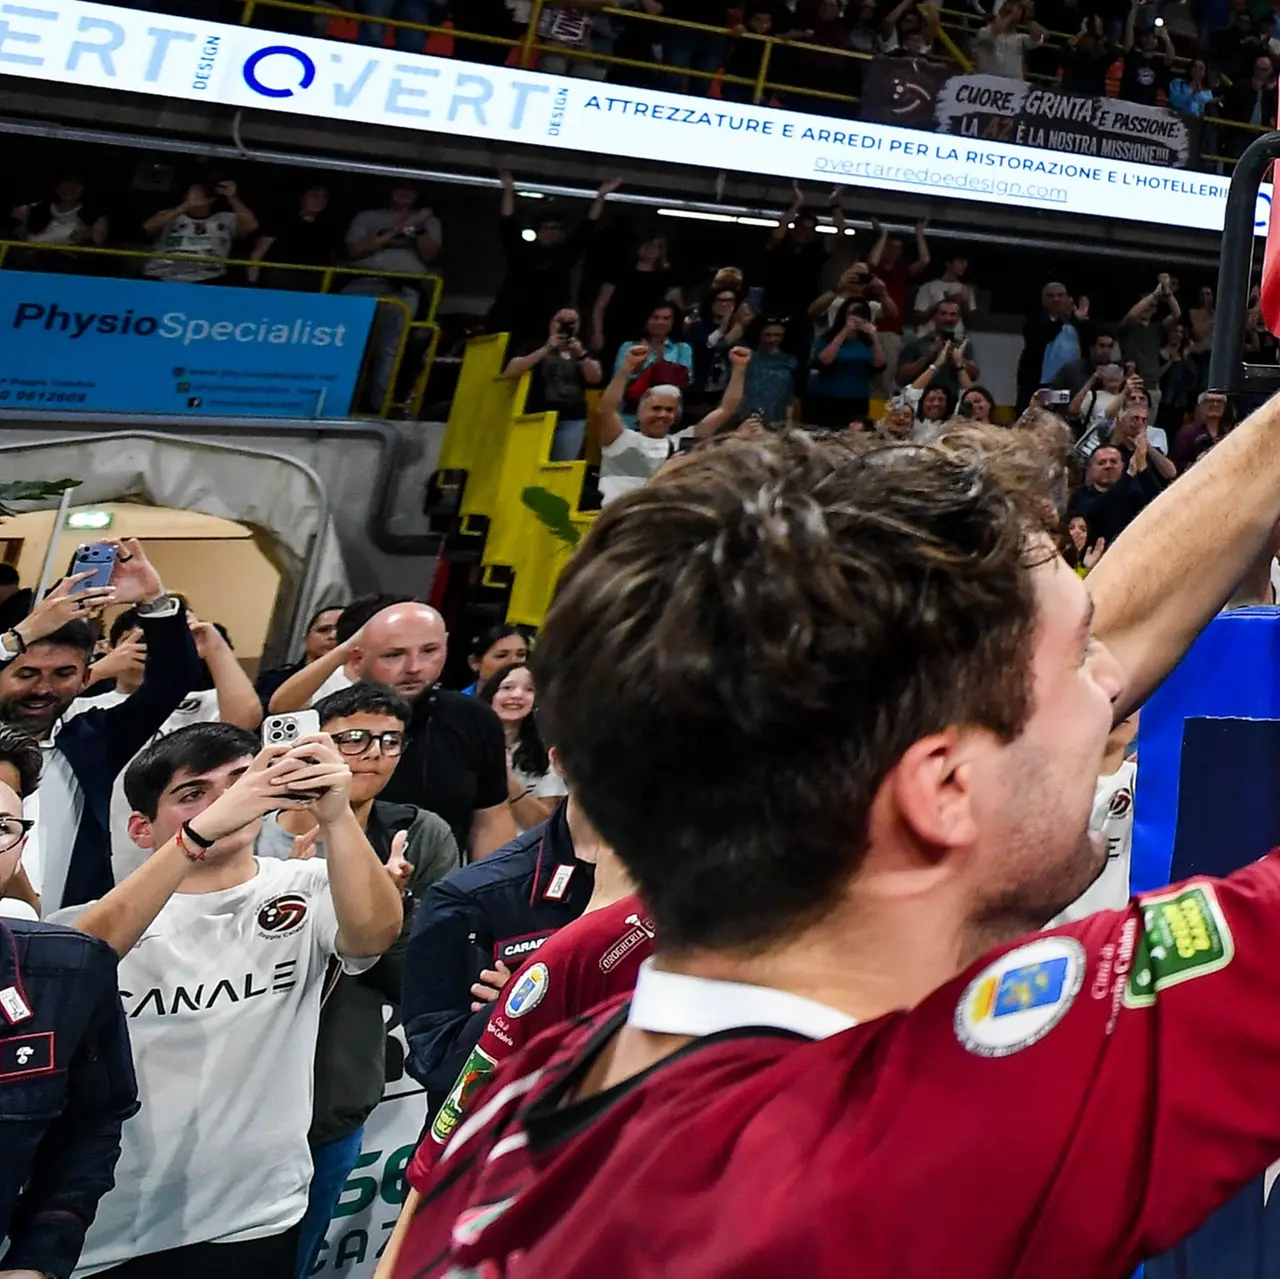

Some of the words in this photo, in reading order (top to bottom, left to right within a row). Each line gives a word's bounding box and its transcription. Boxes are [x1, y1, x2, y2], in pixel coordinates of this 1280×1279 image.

[192, 35, 221, 90] DESIGN
[548, 87, 570, 137] DESIGN
[954, 83, 1016, 114] CUORE,
[1024, 90, 1094, 123] GRINTA
[1111, 113, 1181, 139] PASSIONE:
[584, 95, 774, 135] ATTREZZATURE
[782, 124, 796, 138] E
[801, 126, 883, 151] ARREDI
[889, 140, 930, 159] PER
[935, 145, 959, 162] LA
[966, 150, 1102, 181] RISTORAZIONE
[1107, 170, 1118, 183] E
[960, 116, 979, 137] LA
[1028, 128, 1046, 148] LA
[1048, 130, 1098, 157] NOSTRA
[813, 156, 1068, 202] overtarredoedesign.com
[12, 302, 347, 347] PhysioSpecialist
